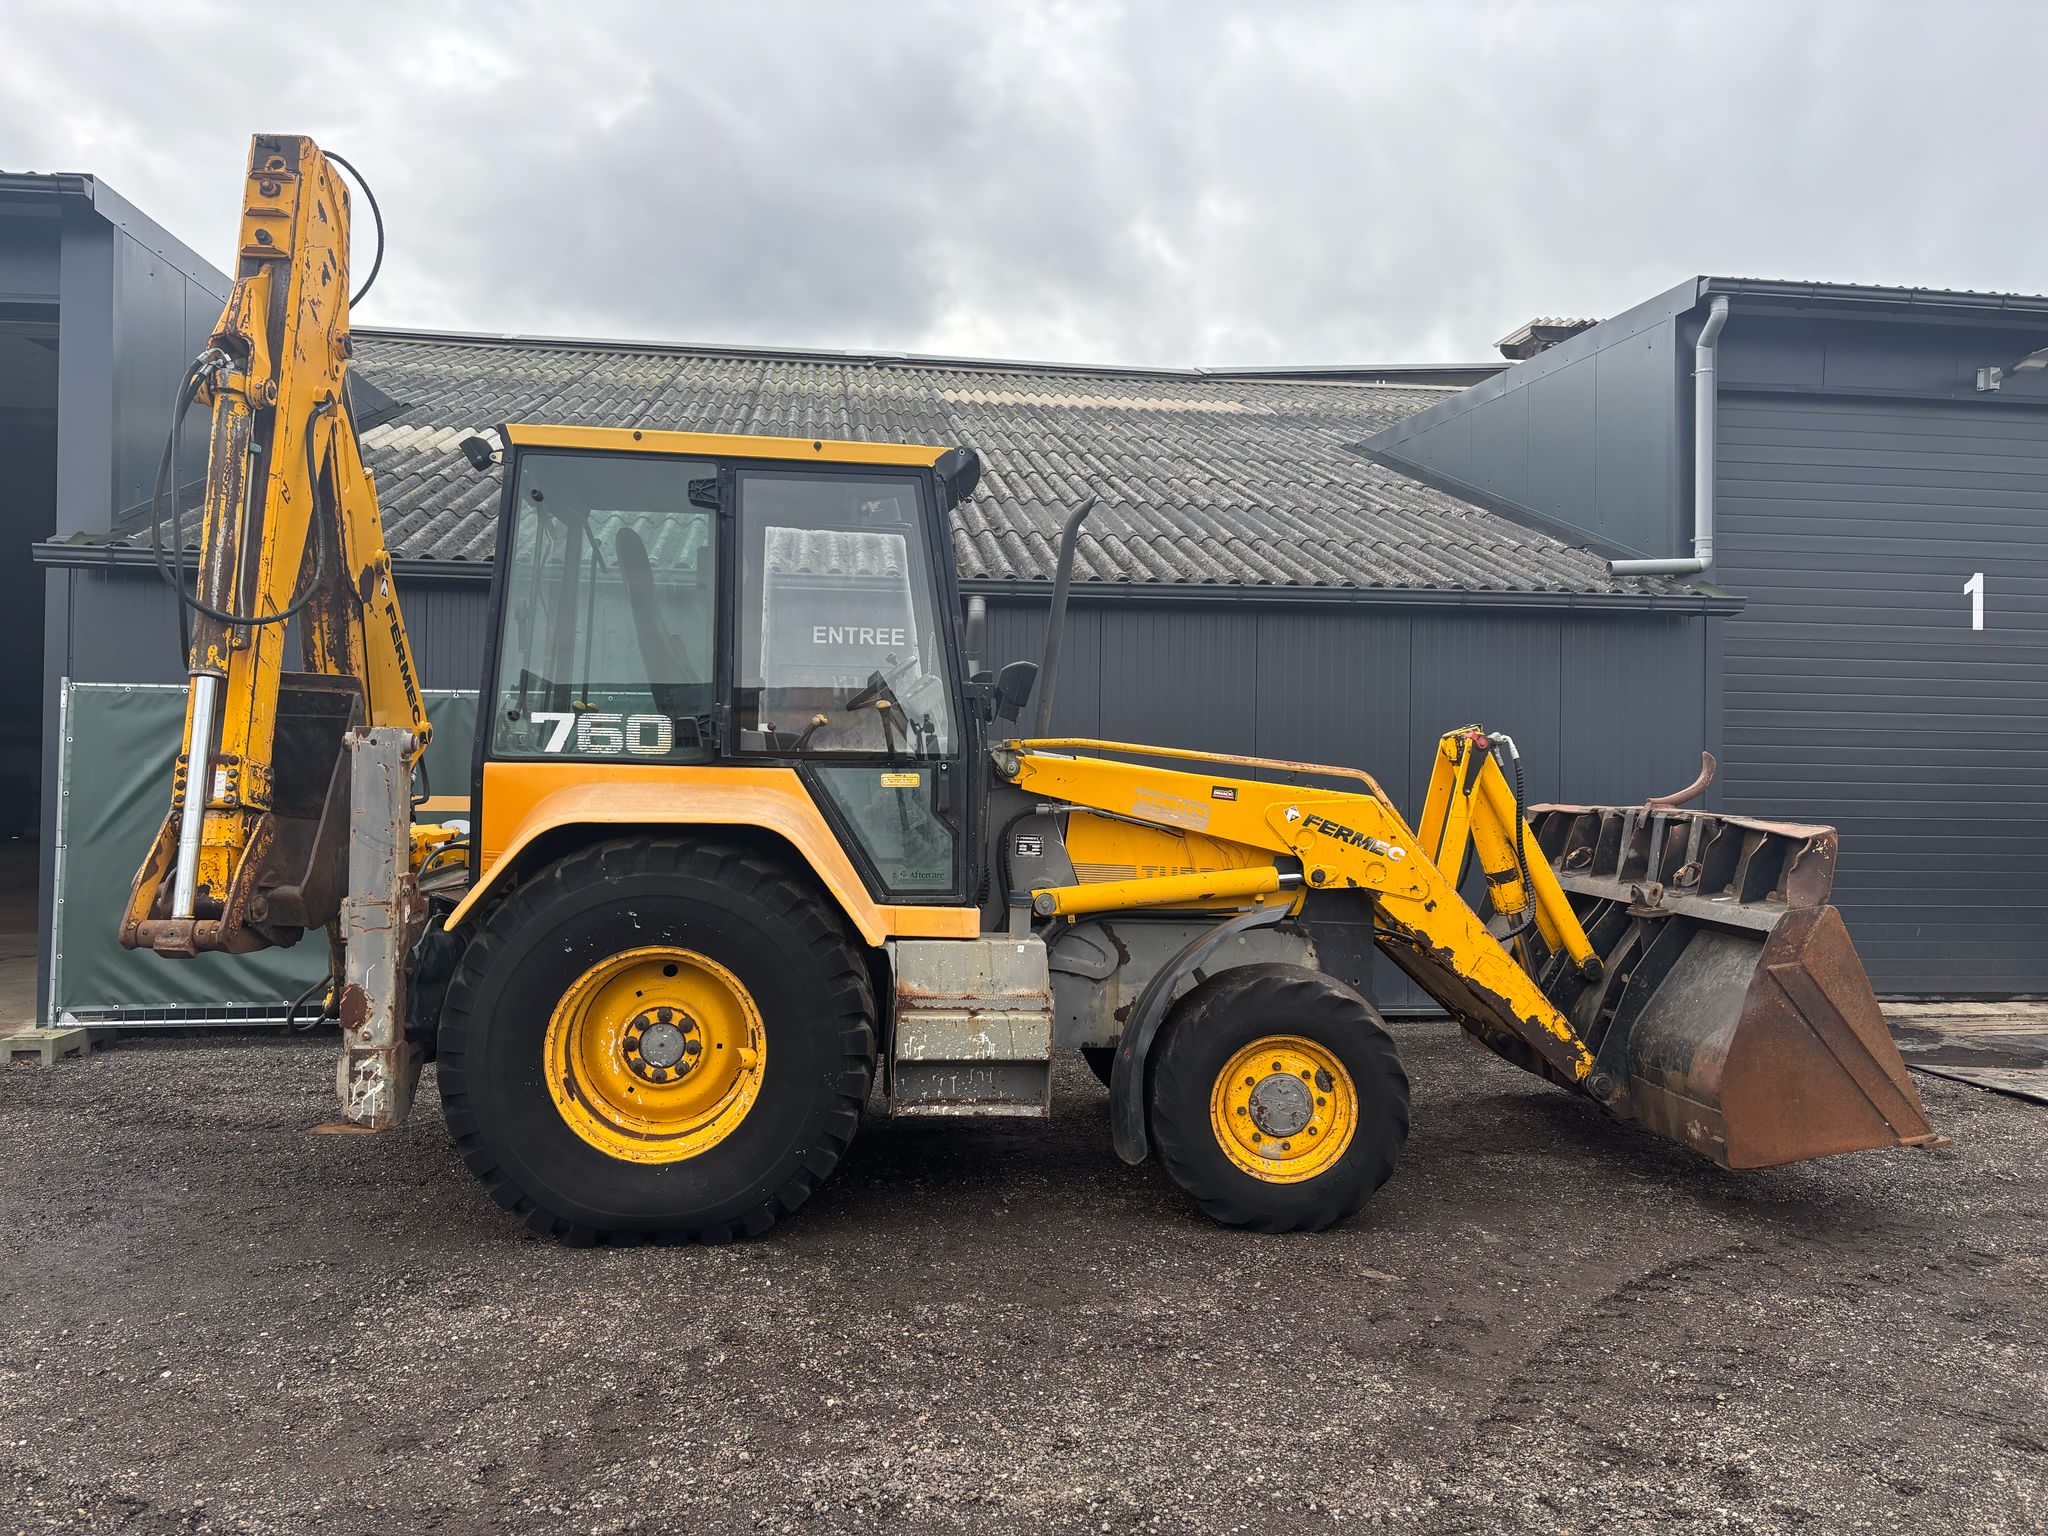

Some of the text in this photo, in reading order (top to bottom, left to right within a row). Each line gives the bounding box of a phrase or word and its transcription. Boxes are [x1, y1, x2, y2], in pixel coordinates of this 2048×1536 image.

[1964, 572, 1984, 631] 1
[813, 626, 905, 646] ENTREE
[385, 601, 421, 727] FERMEC
[530, 712, 673, 755] 760
[1302, 813, 1406, 862] FERMEC
